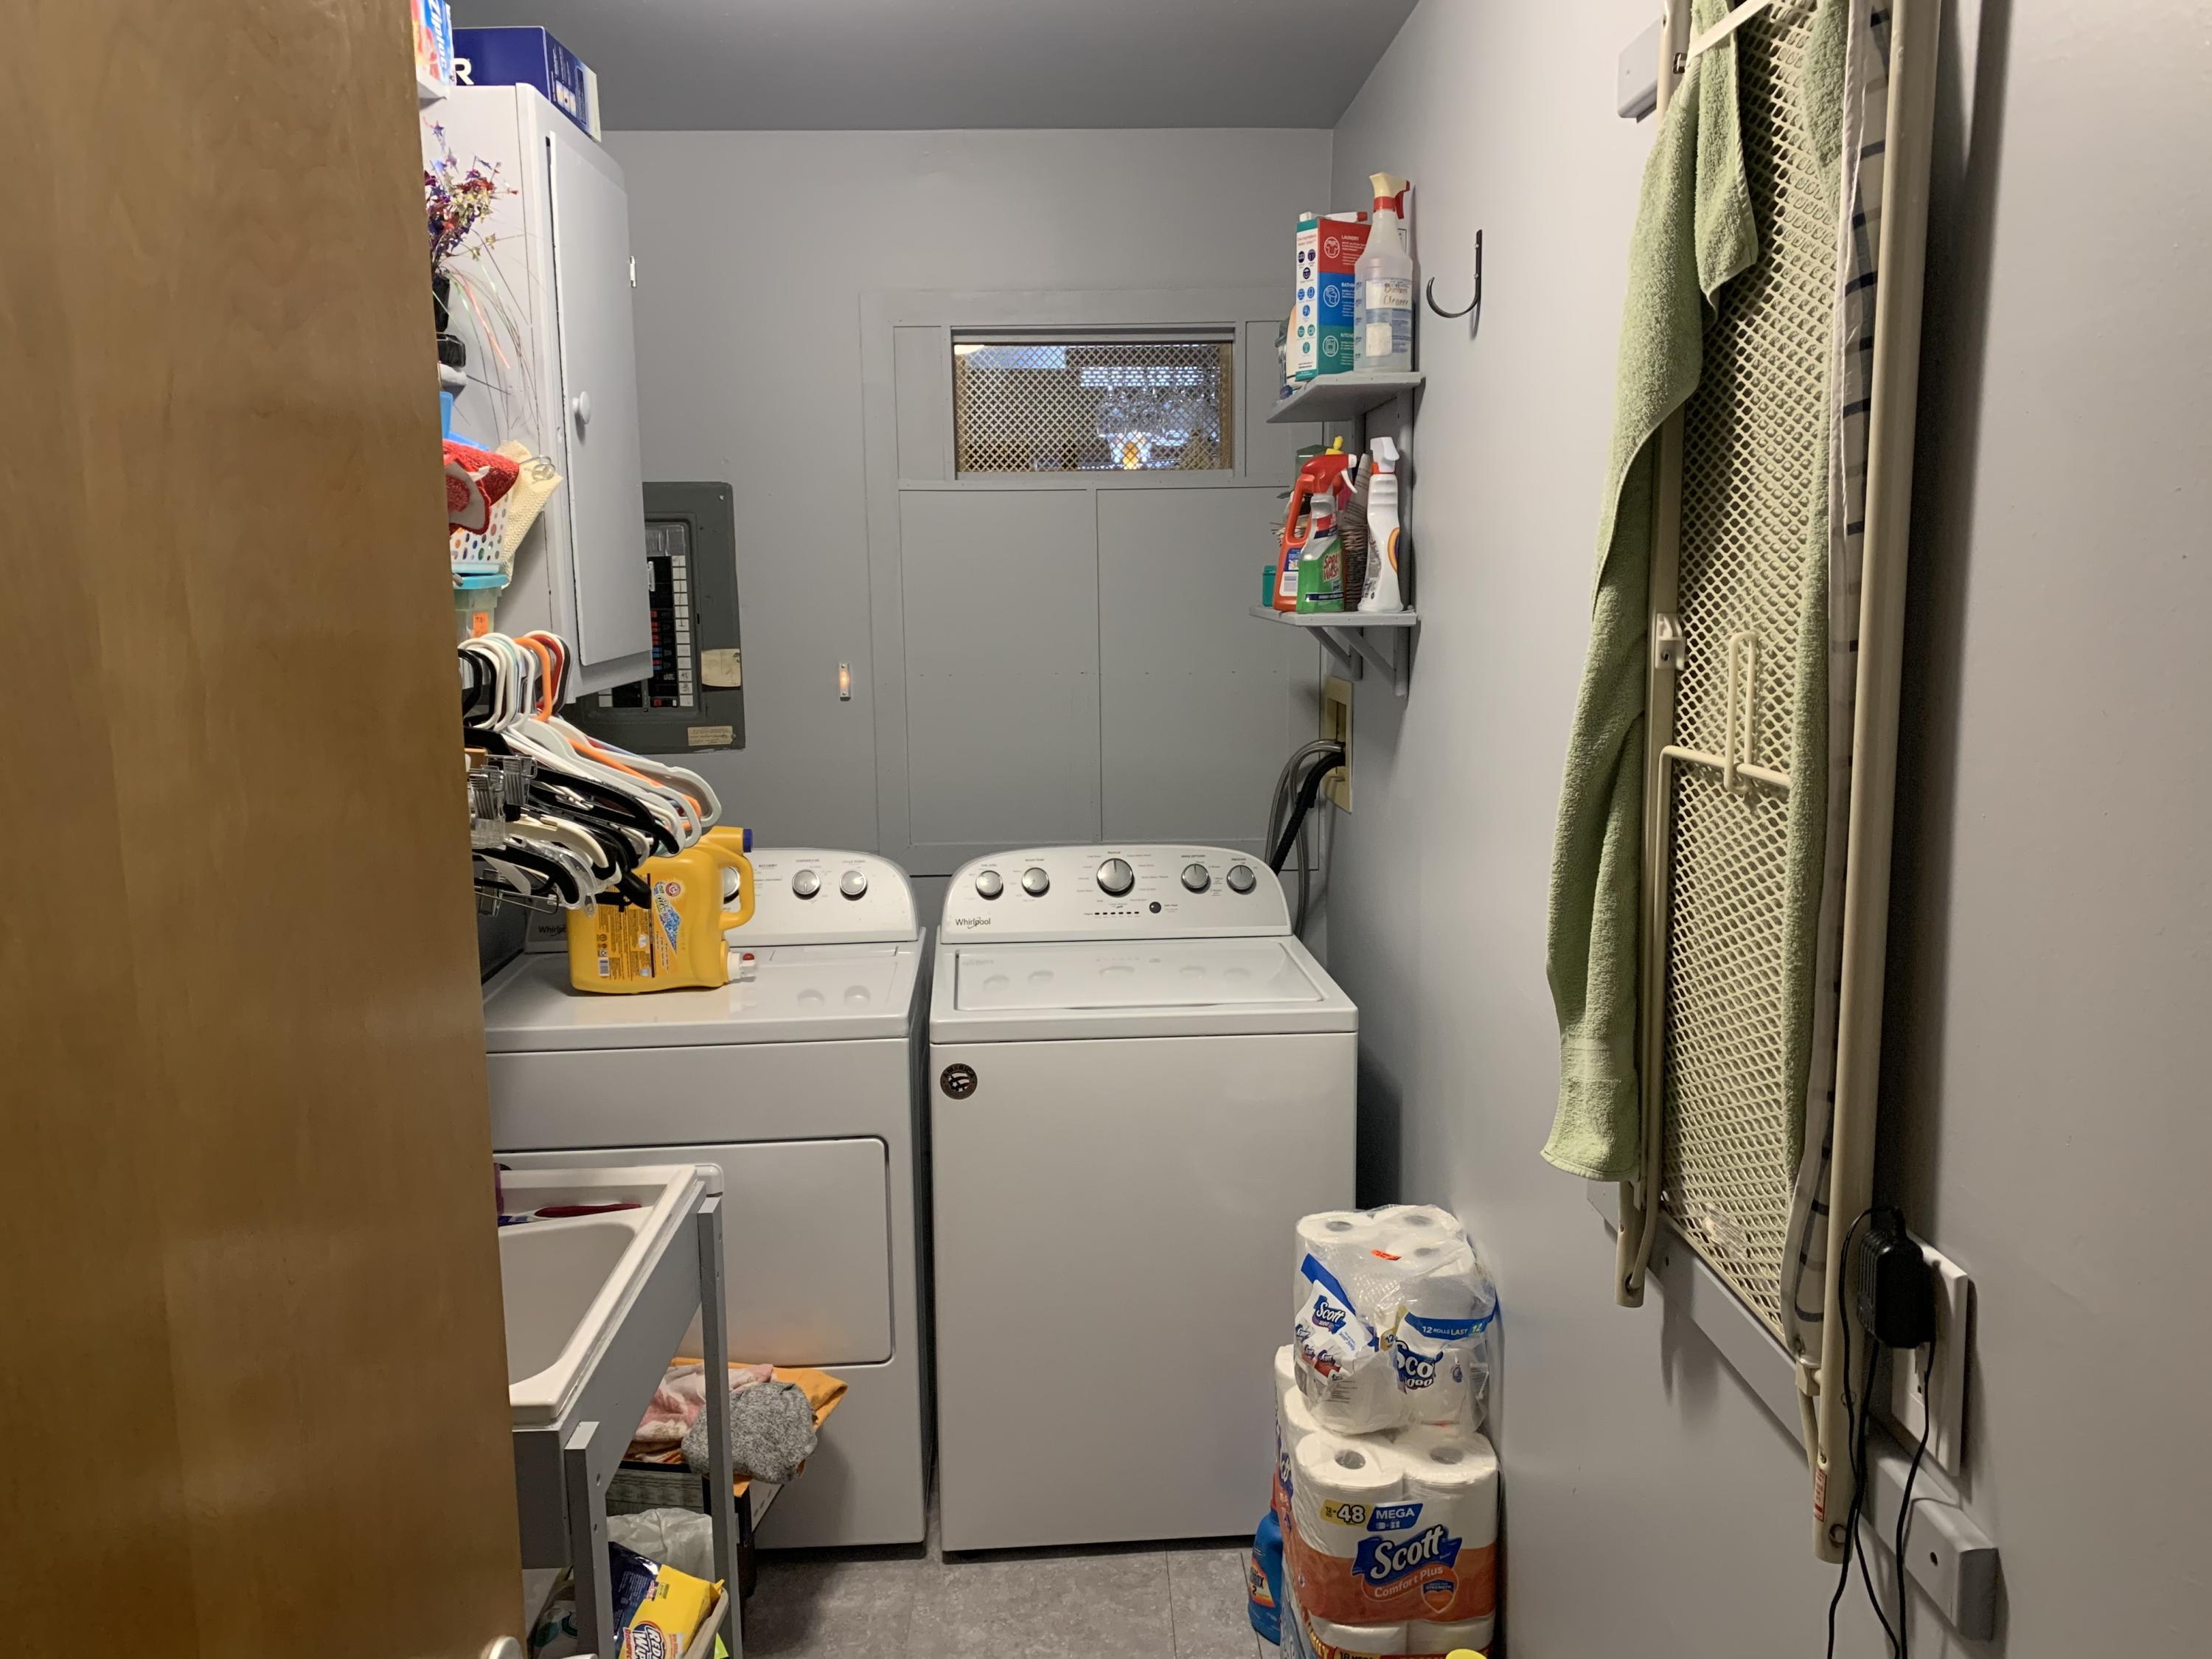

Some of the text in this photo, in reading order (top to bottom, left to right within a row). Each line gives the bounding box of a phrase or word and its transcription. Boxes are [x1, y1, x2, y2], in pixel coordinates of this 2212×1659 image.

[955, 918, 991, 927] Whirlpool
[1316, 1301, 1345, 1323] Scott
[1422, 1326, 1433, 1334] 12
[1405, 1378, 1433, 1387] 000
[1337, 1504, 1365, 1524] 48
[1375, 1508, 1415, 1520] MEGA
[1370, 1526, 1444, 1579] Scott
[1374, 1566, 1444, 1598] Comfort Plus
